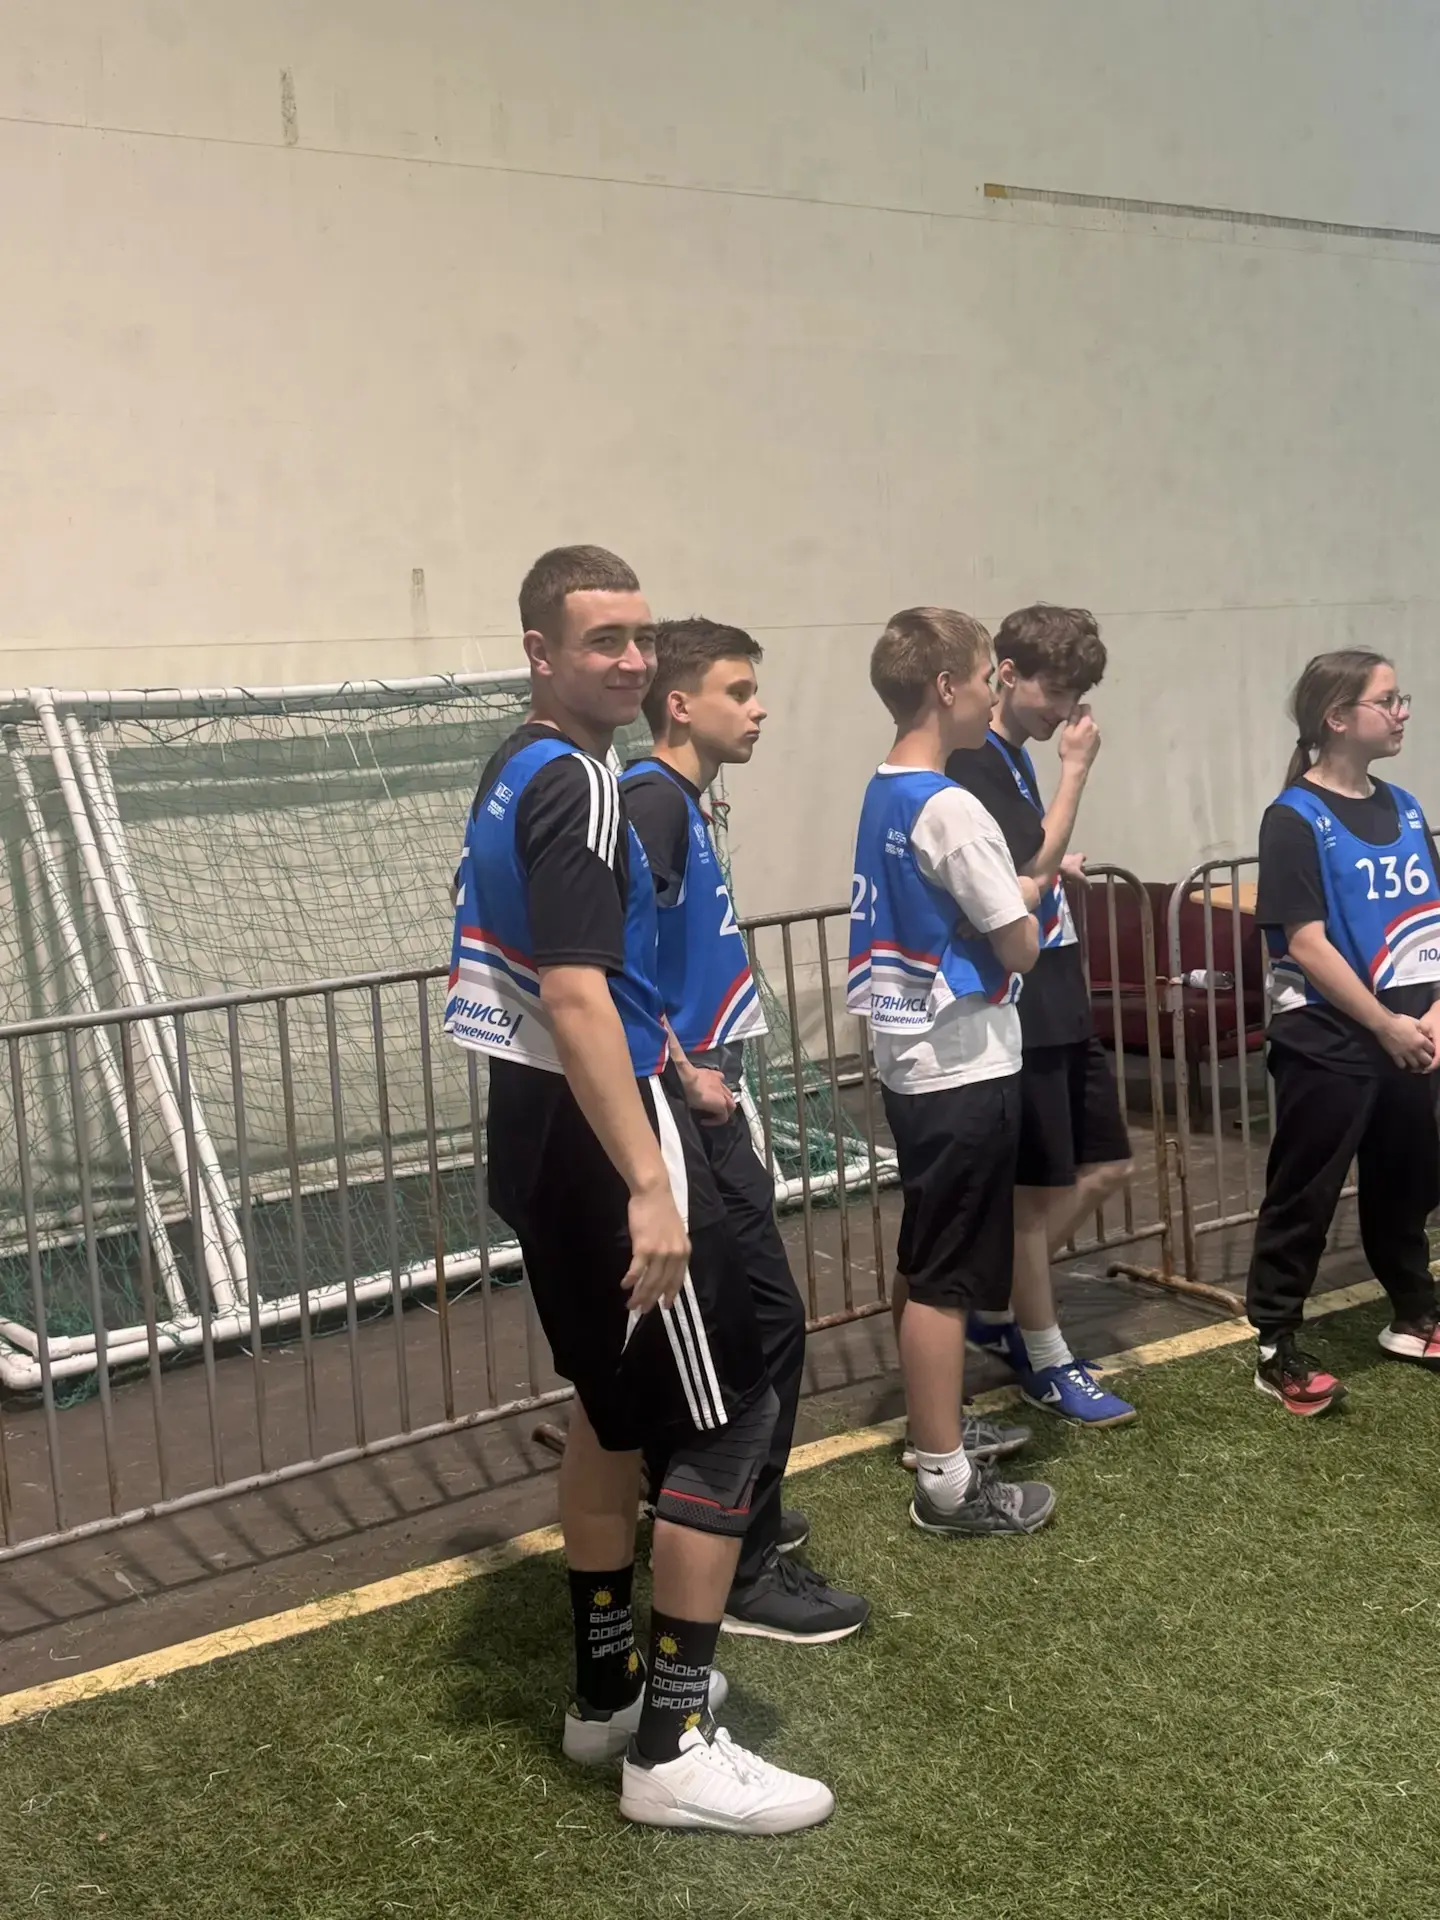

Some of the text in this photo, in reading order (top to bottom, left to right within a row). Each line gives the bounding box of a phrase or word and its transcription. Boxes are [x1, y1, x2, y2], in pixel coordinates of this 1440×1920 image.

[850, 873, 878, 928] 2
[1419, 948, 1440, 962] ПО
[871, 993, 928, 1012] ТЯНИСЬ
[651, 1694, 705, 1709] УРОДЫ
